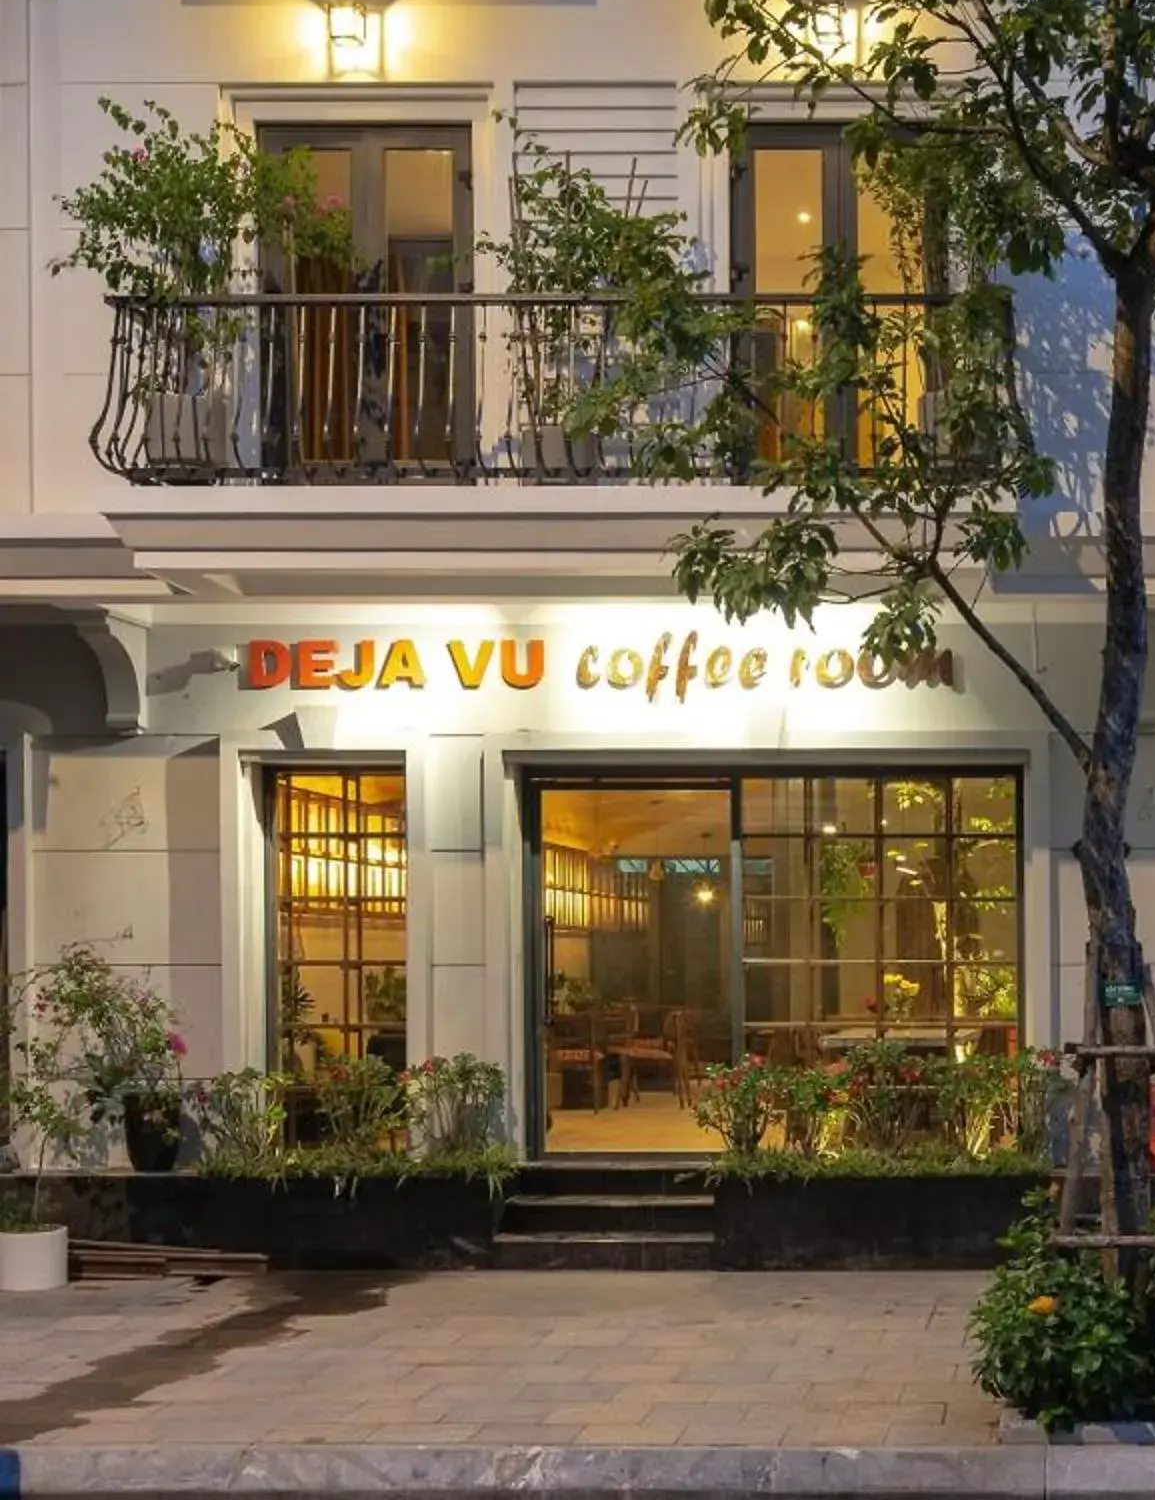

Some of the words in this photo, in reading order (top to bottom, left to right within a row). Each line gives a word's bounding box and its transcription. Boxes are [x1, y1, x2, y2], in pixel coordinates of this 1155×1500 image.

[244, 638, 424, 691] DEJA
[444, 638, 546, 690] VU
[574, 630, 768, 704] coffee
